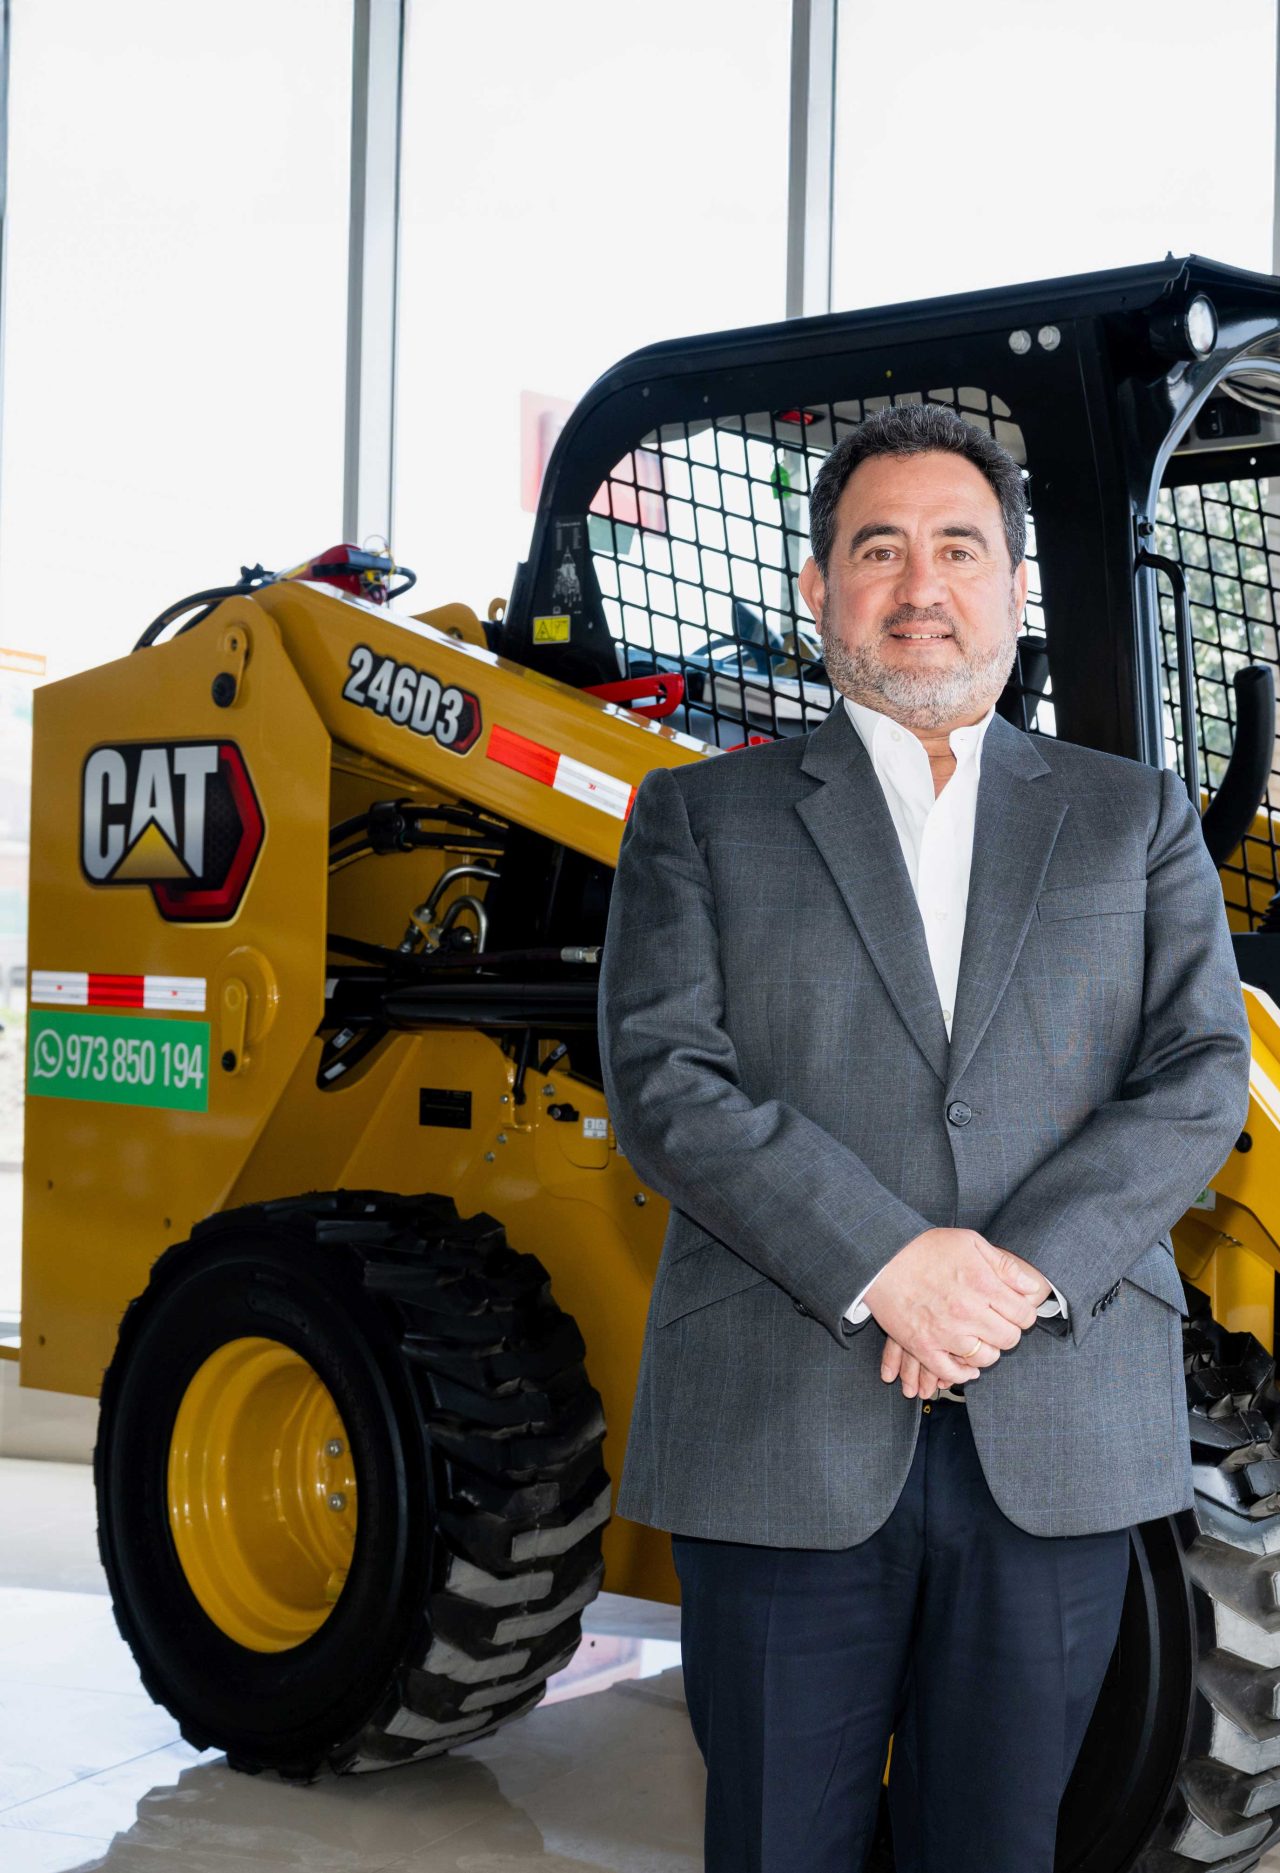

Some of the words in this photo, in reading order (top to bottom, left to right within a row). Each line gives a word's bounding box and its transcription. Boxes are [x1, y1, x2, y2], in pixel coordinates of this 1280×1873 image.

[344, 647, 464, 745] 246D3
[84, 745, 219, 879] CAT
[66, 1034, 108, 1082] 973
[112, 1038, 156, 1086] 850
[161, 1042, 204, 1090] 194
